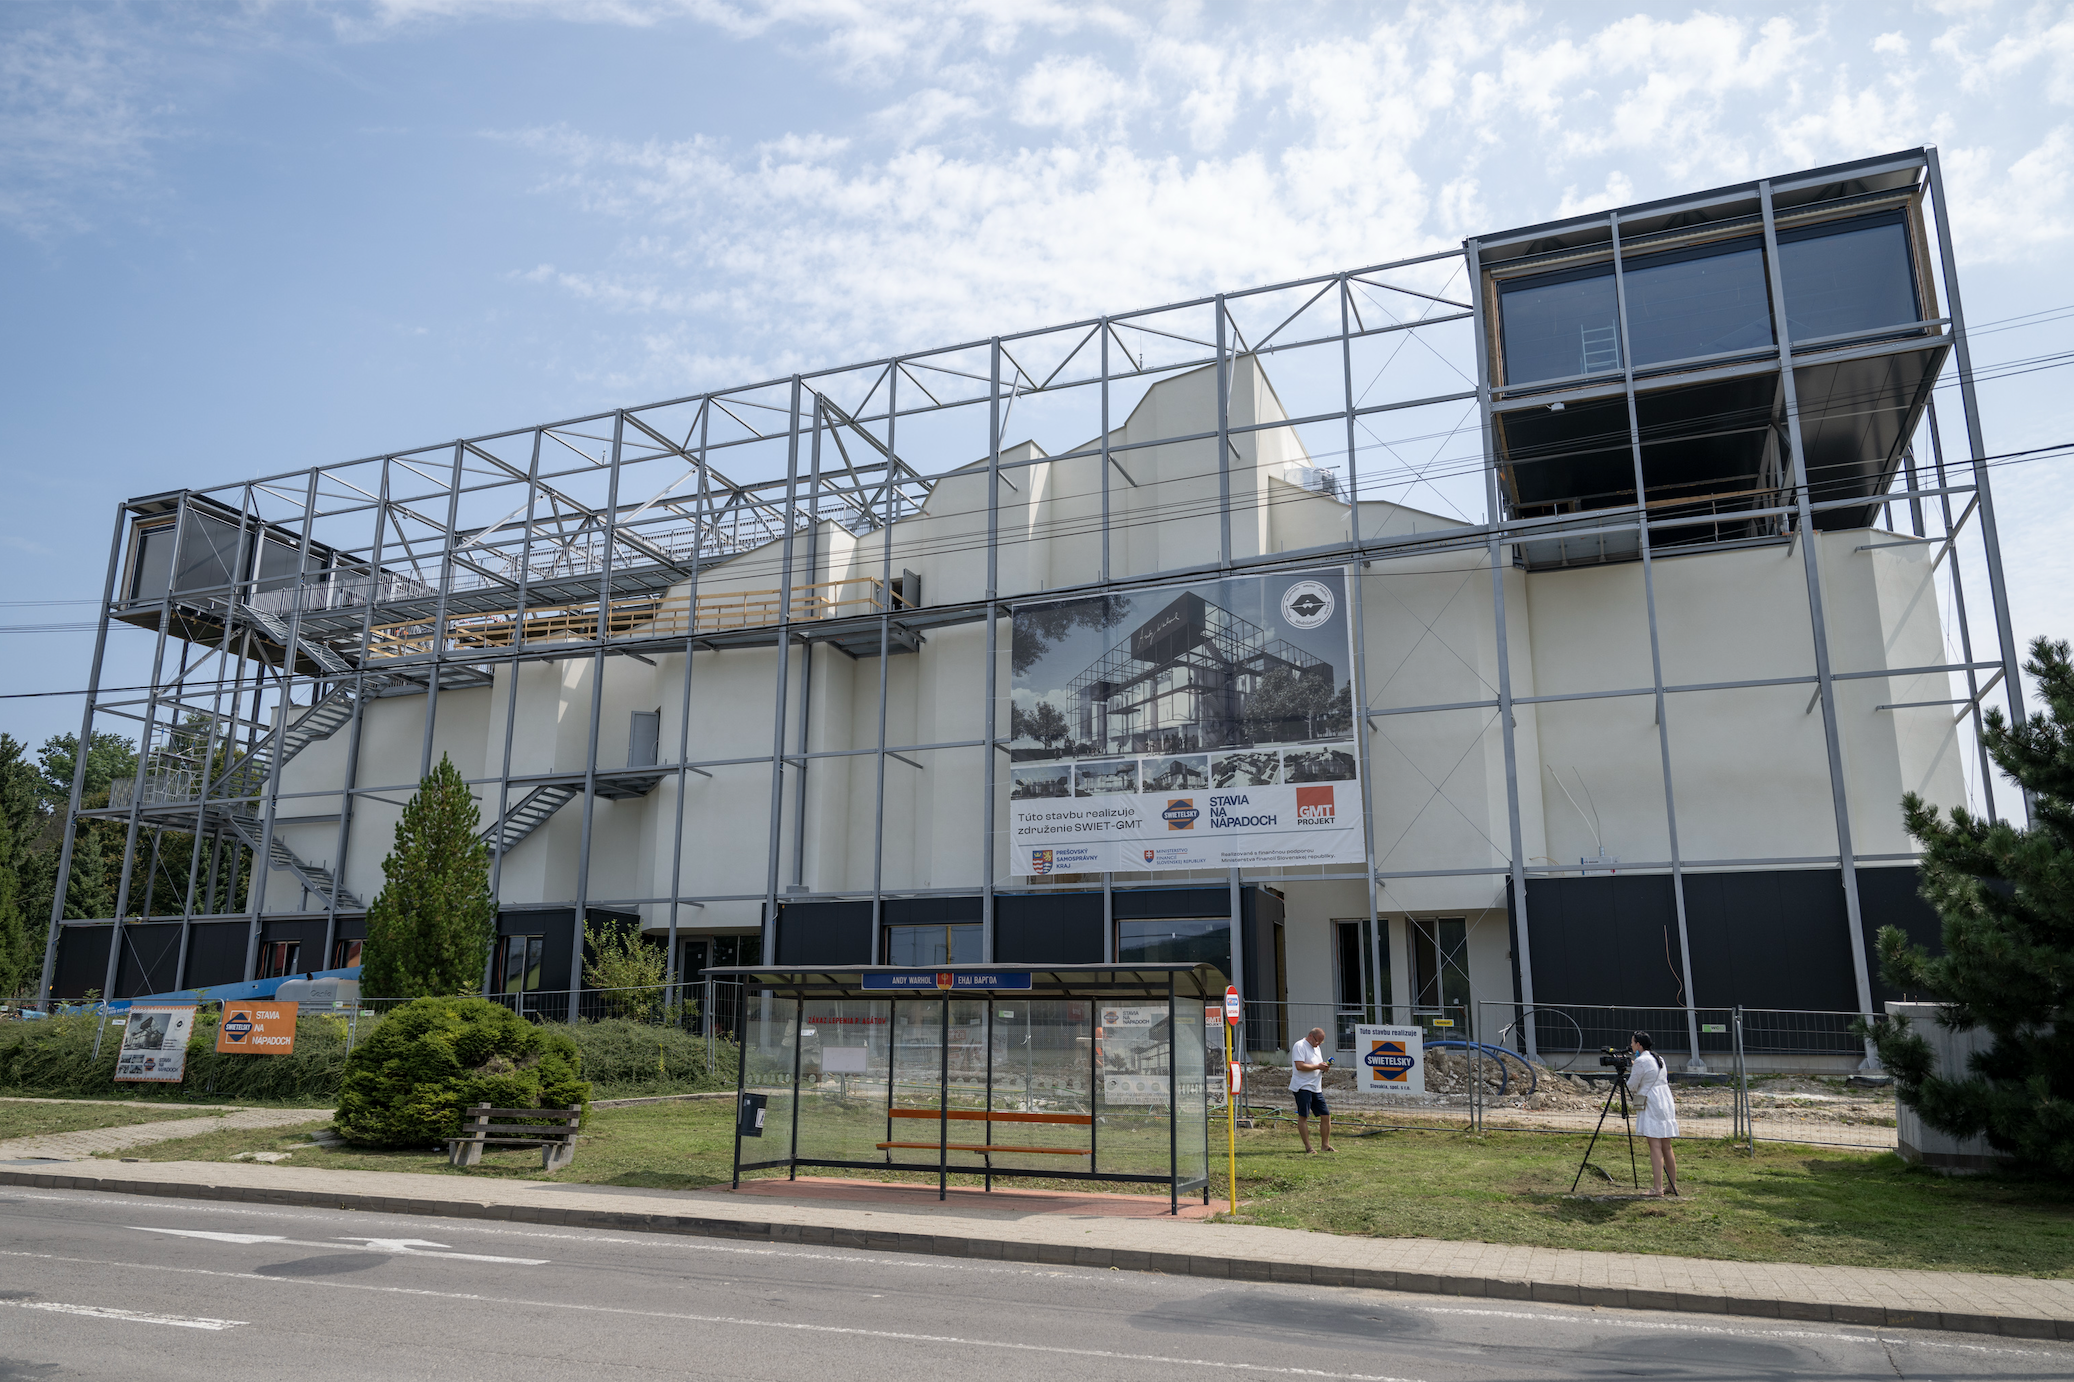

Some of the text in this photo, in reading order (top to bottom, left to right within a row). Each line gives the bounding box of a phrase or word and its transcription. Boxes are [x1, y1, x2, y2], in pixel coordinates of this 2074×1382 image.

[1210, 794, 1249, 806] STAVIA
[1018, 808, 1135, 822] Túto stavbu realizuje
[1164, 810, 1198, 818] SWIETELSKY
[1210, 807, 1227, 817] NA
[1299, 804, 1333, 817] GMT
[1210, 815, 1277, 828] NÁPADOCH
[1298, 818, 1335, 826] PROJEKT
[1018, 820, 1143, 834] združenie SWIET-GMT
[892, 976, 932, 984] ANDY WARHOL
[958, 976, 998, 984] ЕНДІ ВАРГОЛ
[256, 1011, 280, 1019] STAVIA
[808, 1015, 827, 1024] ZÁKAZ
[254, 1024, 264, 1032] NA
[1392, 1029, 1417, 1037] realizuje
[252, 1035, 291, 1045] NÁPADOCH
[1367, 1056, 1411, 1066] SWIETELSKY
